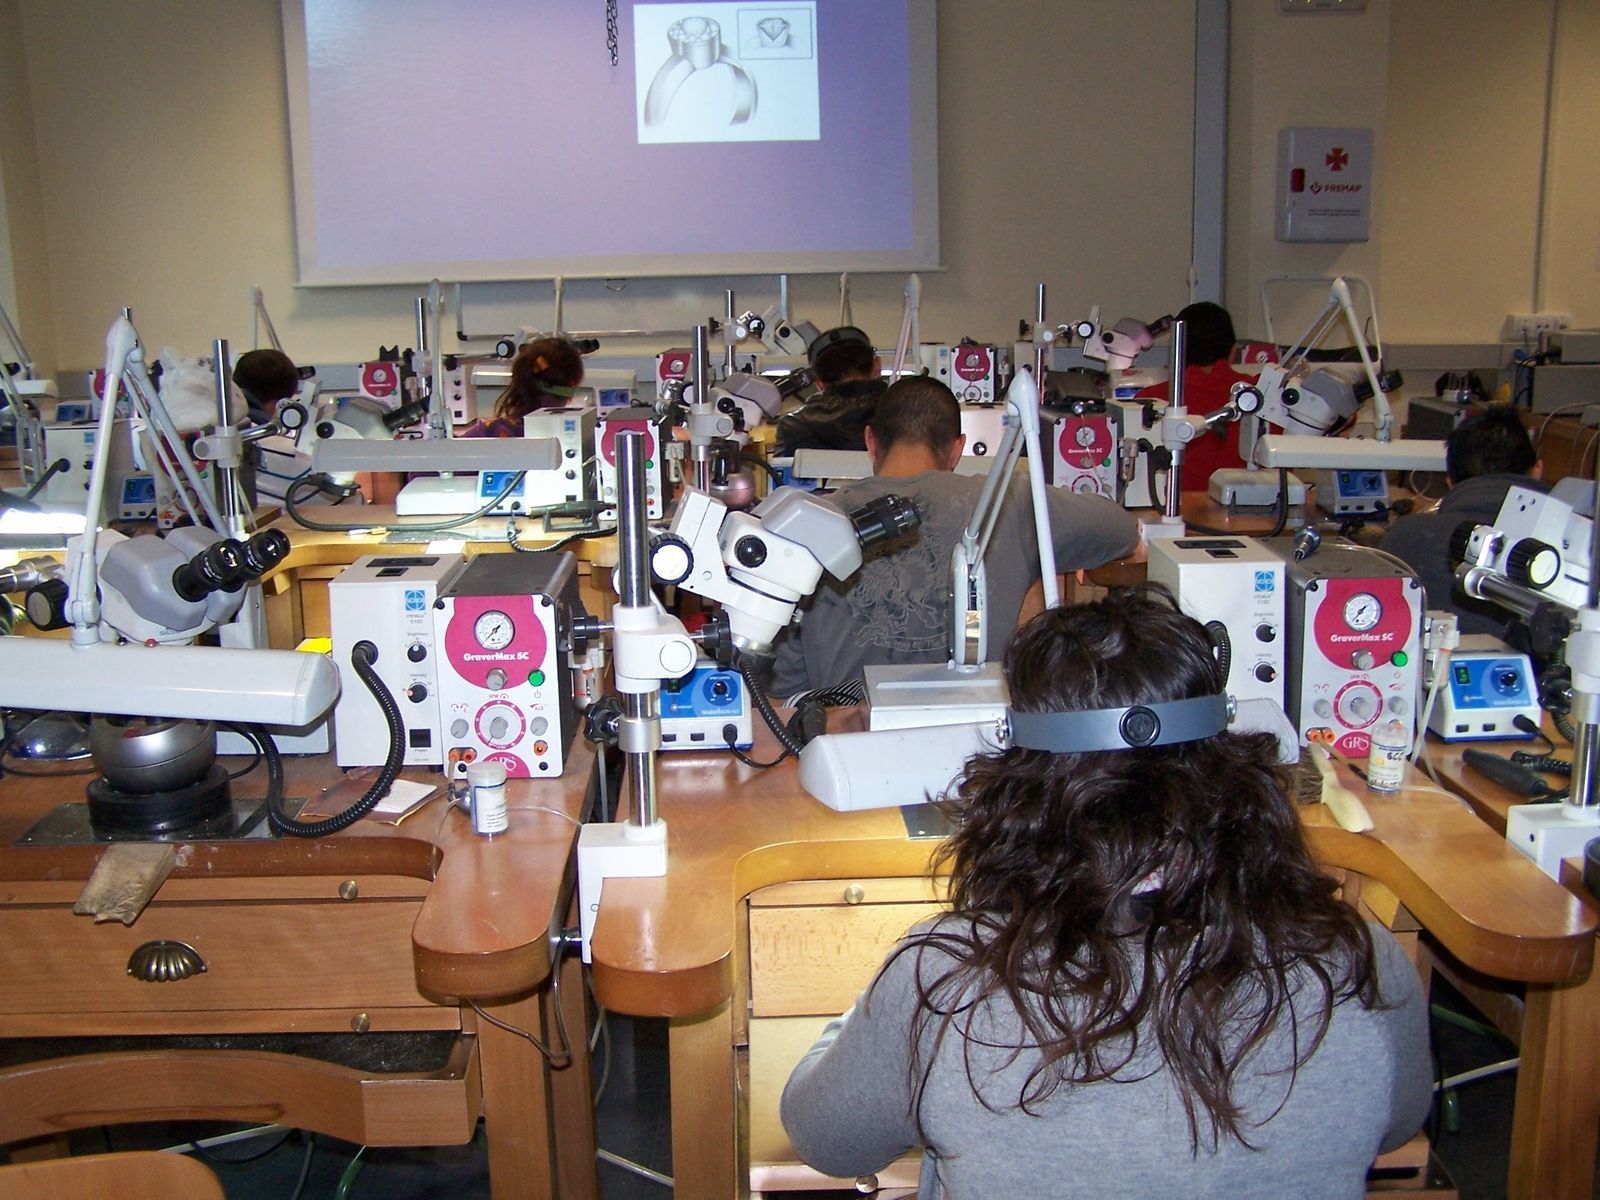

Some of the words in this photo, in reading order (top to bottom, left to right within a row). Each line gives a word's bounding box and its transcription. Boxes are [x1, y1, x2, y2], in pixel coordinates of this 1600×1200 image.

[1324, 184, 1362, 193] FREMAP
[1330, 633, 1381, 643] GraverMax
[1382, 632, 1394, 641] SC
[463, 652, 516, 662] GraverMax
[516, 651, 530, 660] SC
[1342, 735, 1370, 752] GRS
